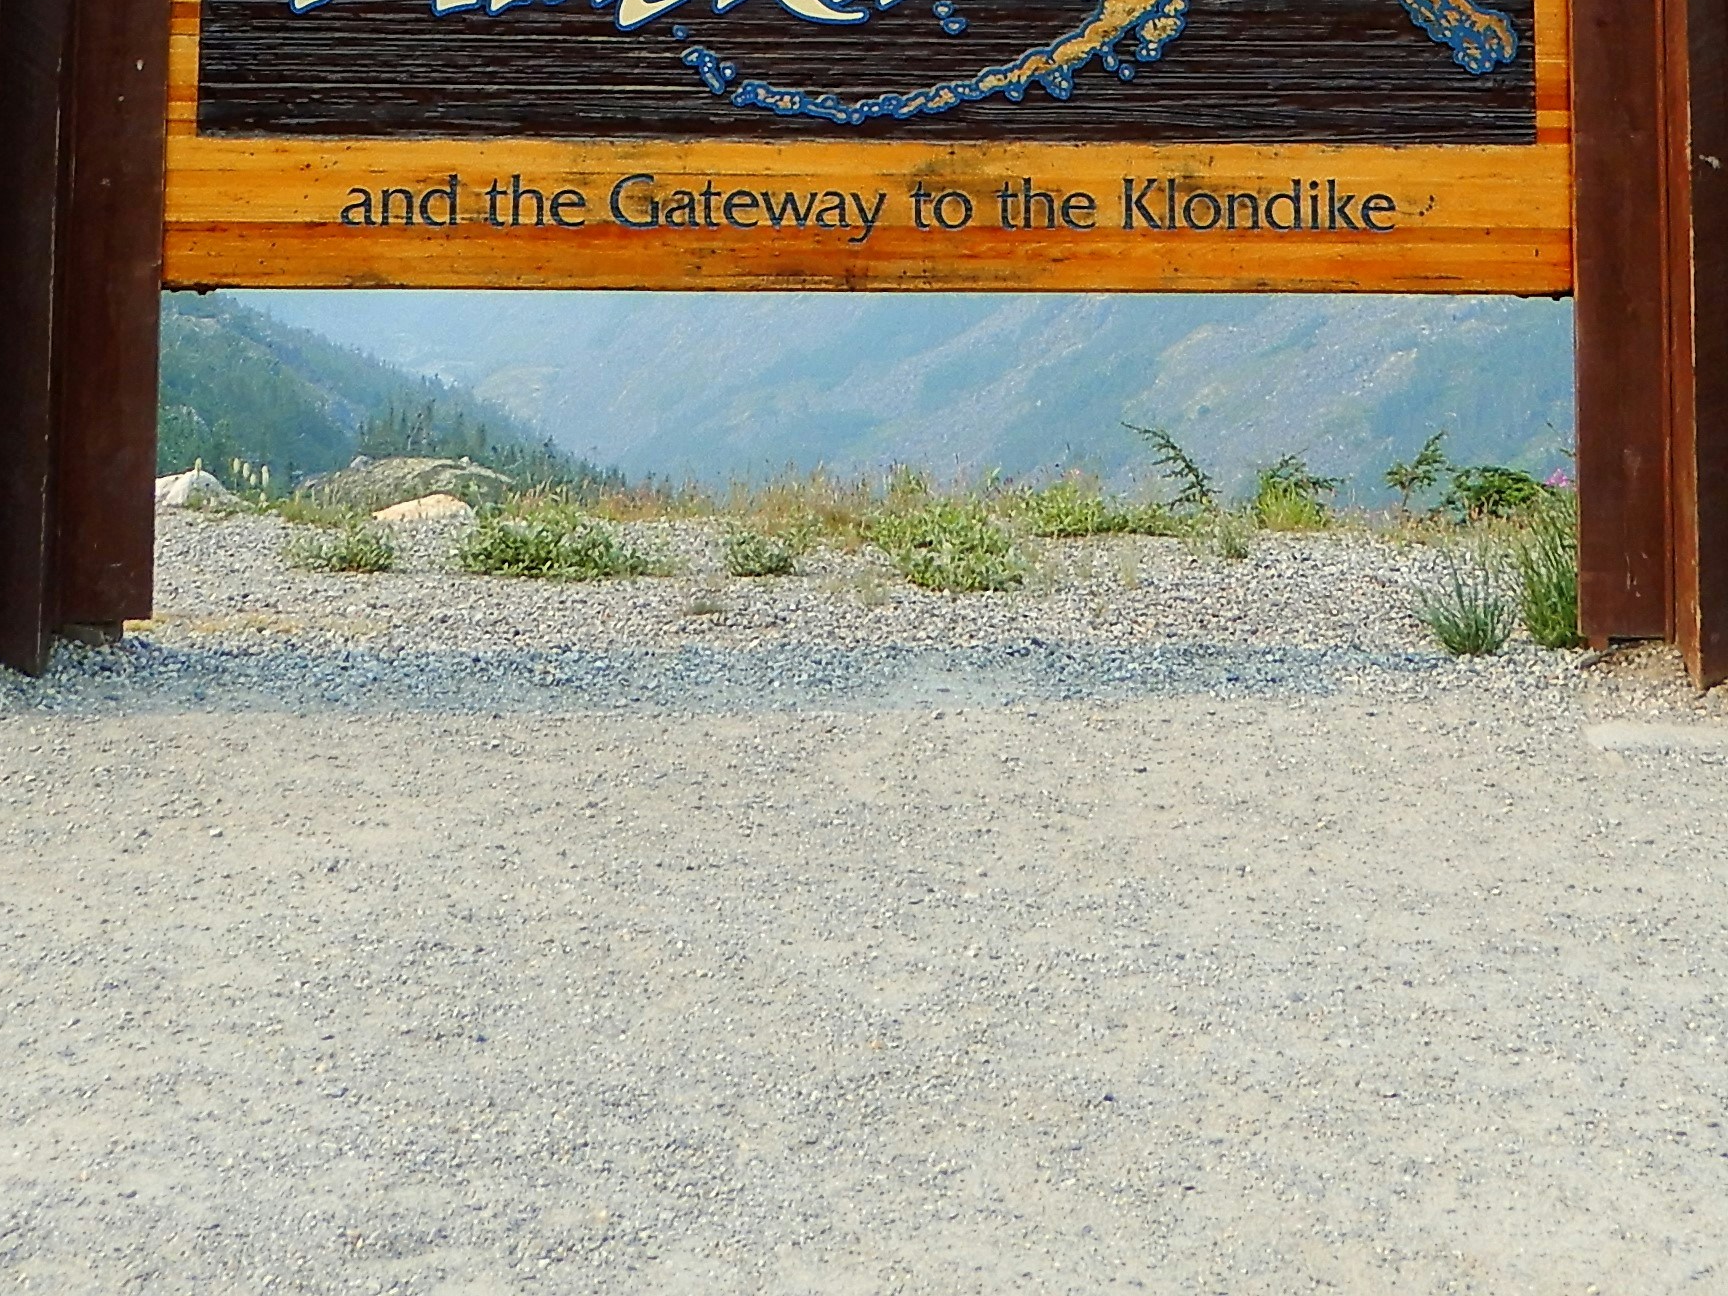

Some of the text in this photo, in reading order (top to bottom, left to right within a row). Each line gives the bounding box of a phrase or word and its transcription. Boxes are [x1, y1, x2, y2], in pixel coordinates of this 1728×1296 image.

[339, 174, 1398, 242] and the Gateway to the Klondike
